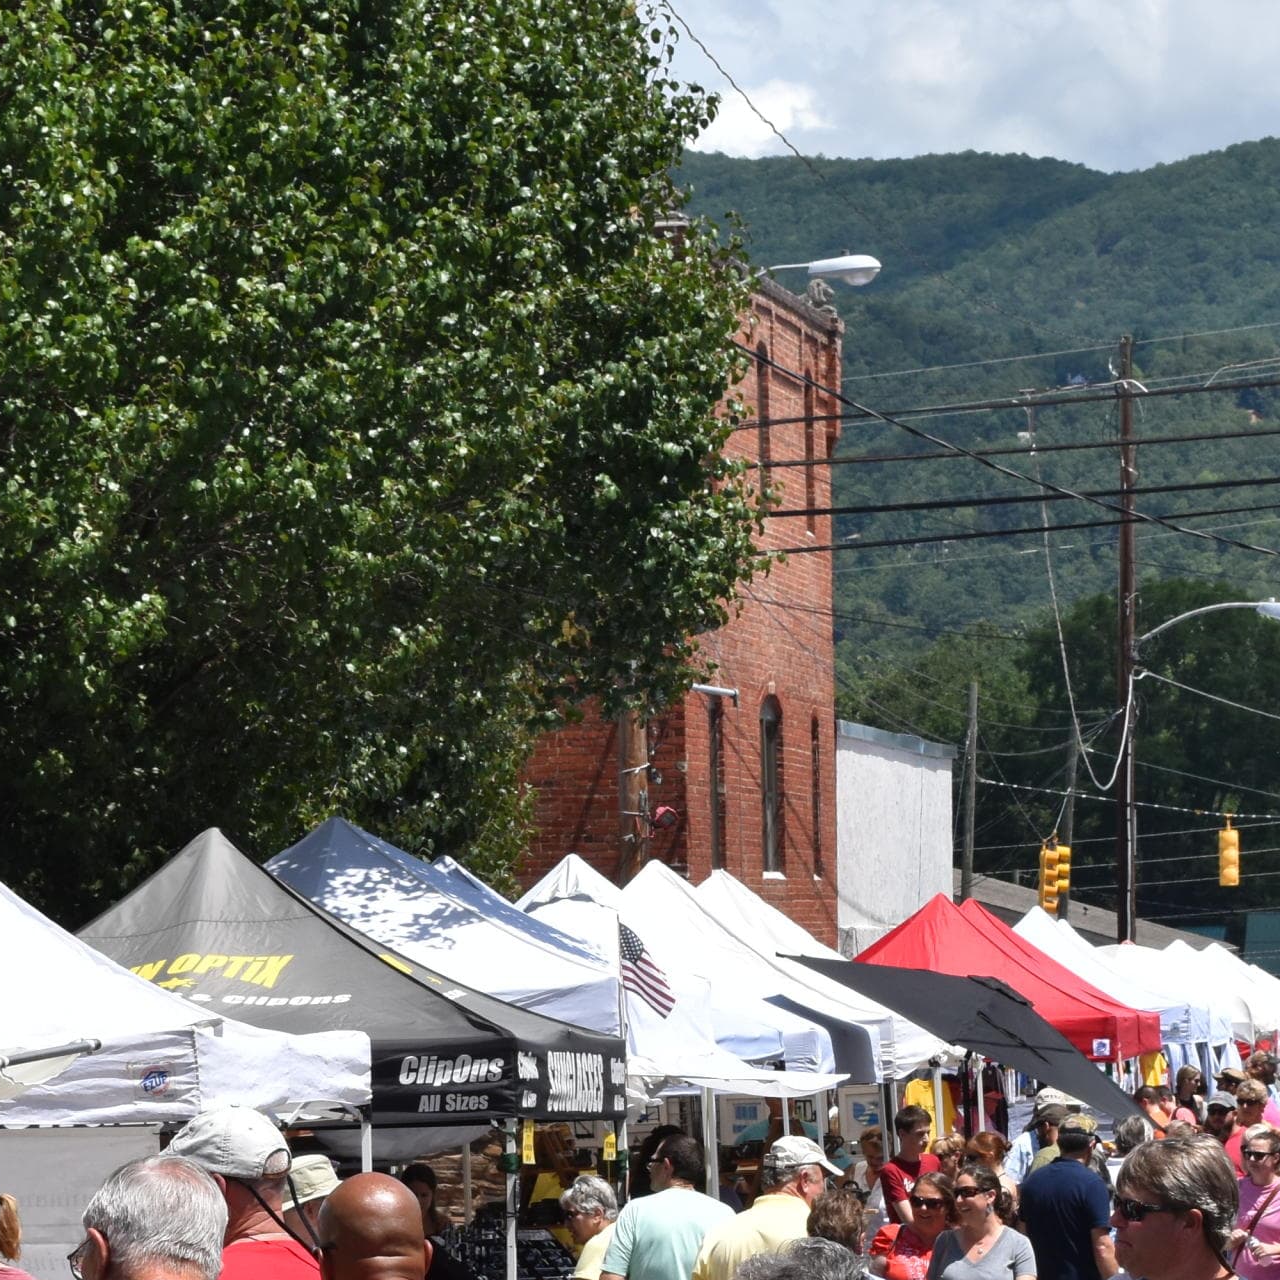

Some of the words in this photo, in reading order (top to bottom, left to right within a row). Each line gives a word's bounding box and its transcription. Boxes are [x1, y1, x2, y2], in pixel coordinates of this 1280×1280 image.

[398, 1053, 505, 1087] ClipOns
[547, 1050, 604, 1113] SUNGLASSES
[417, 1094, 441, 1113] All
[445, 1093, 489, 1112] Sizes
